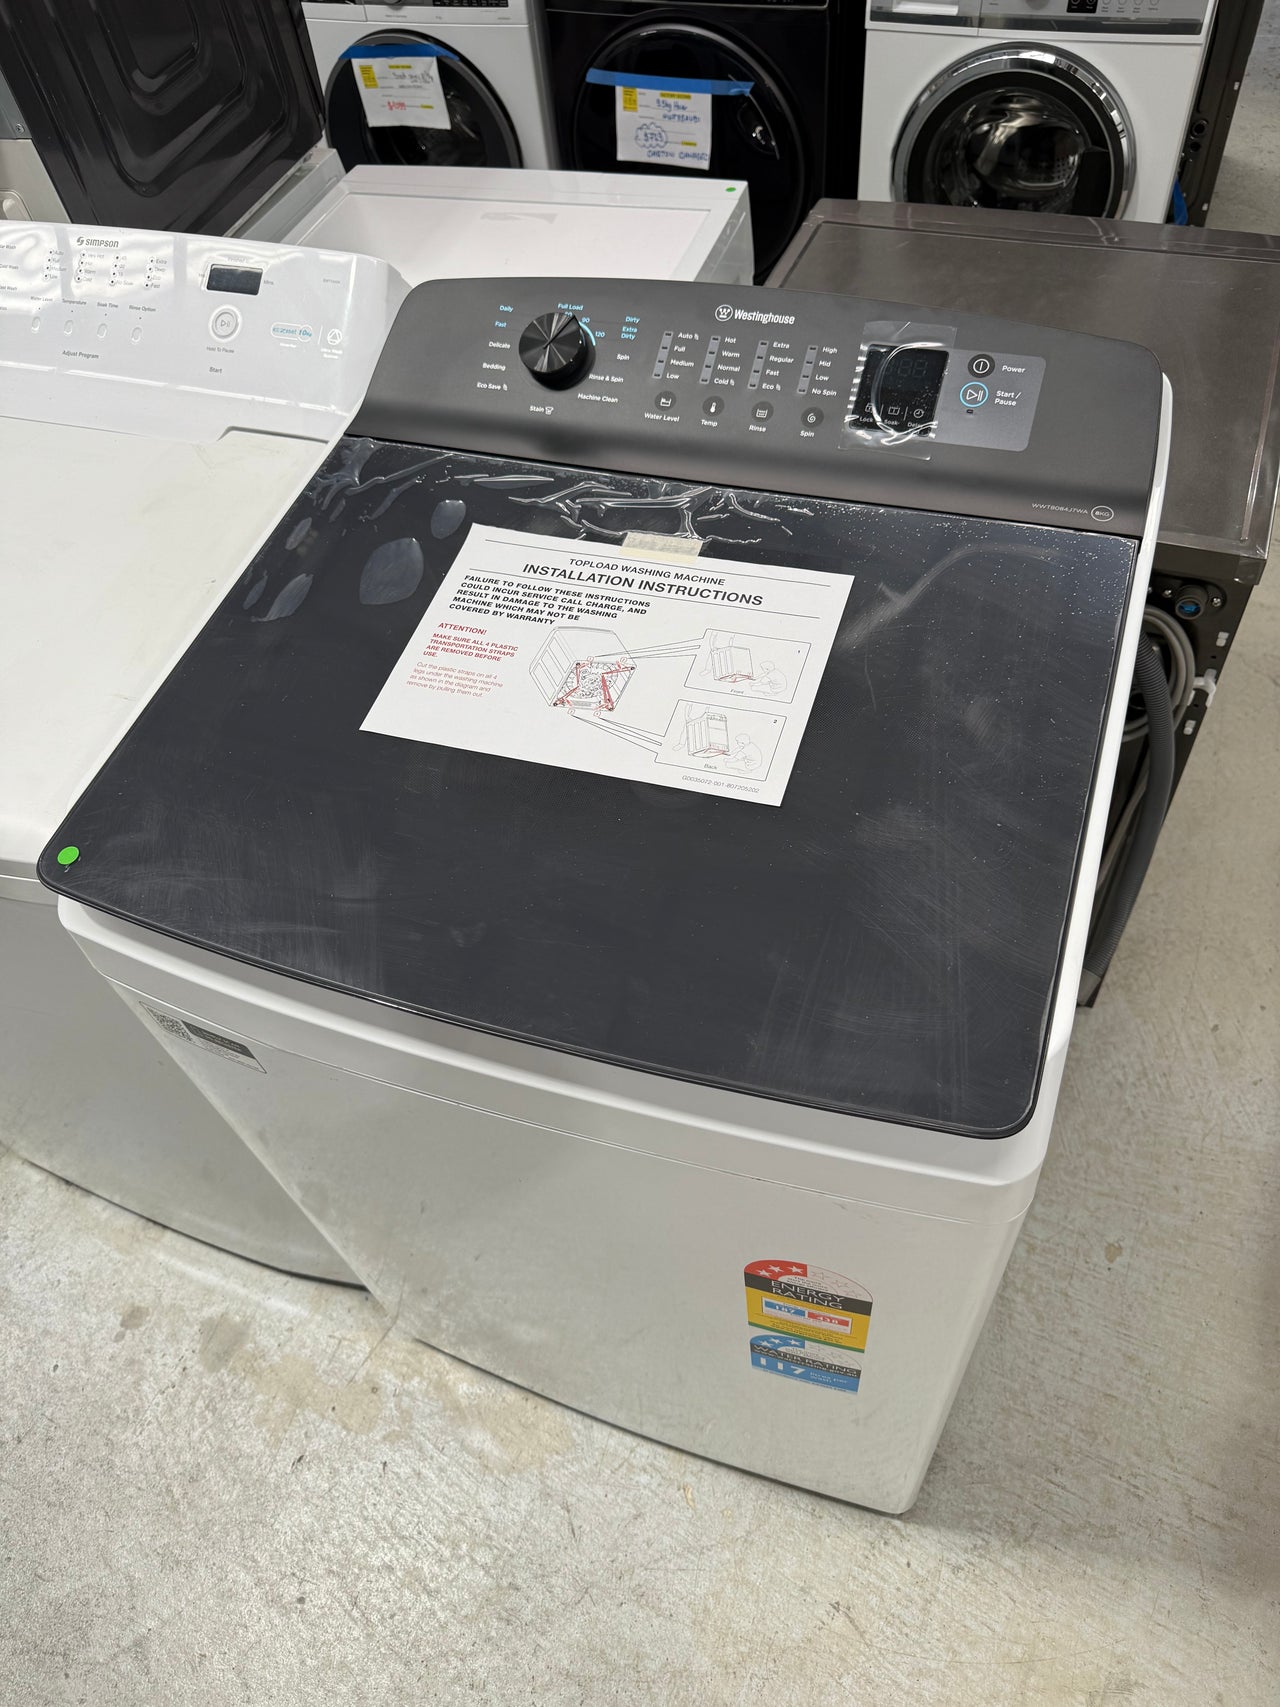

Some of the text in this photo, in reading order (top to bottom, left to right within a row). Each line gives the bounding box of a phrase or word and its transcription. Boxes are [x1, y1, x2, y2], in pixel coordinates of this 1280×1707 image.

[86, 238, 119, 248] SIMPSON
[500, 305, 514, 313] Daily
[626, 316, 640, 324] Dirty
[734, 309, 796, 325] Westinghouse
[621, 332, 636, 341] Dirty
[488, 341, 511, 349] Delicate
[62, 350, 100, 360] Adjust Program
[822, 346, 838, 355] High
[617, 353, 630, 361] Spin
[769, 355, 794, 365] Regular
[482, 363, 506, 372] Bedding
[670, 359, 694, 368] Medium
[718, 364, 740, 372] Normal
[819, 360, 831, 368] Mid
[766, 369, 780, 377] Fast
[1002, 365, 1026, 374] Power
[589, 374, 604, 382] Rinse
[610, 376, 624, 384] Spin
[816, 374, 830, 382] Low
[822, 389, 837, 397] Spin
[996, 390, 1014, 399] Start
[578, 393, 619, 403] Machine Clean
[995, 398, 1017, 406] Pause
[529, 405, 545, 413] Stain
[644, 412, 680, 423] Water Level
[701, 419, 718, 428] Temp
[749, 425, 767, 433] Rinse
[800, 430, 815, 438] Spin
[569, 559, 726, 586] TOPLOAD WASHING MACHINE
[523, 563, 764, 606] INSTALLATION INSTRUCTIONS
[465, 575, 500, 585] FAILURE
[516, 583, 552, 592] FOLLOW
[555, 588, 583, 598] THESE
[585, 593, 651, 608] INSTRUCTIONS
[461, 582, 490, 591] COULD
[492, 587, 520, 596] INCUR
[521, 592, 559, 602] SERVICE
[561, 598, 583, 606] CALL
[586, 601, 625, 612] CHARGE,
[453, 596, 493, 608] MACHINE
[495, 603, 524, 612] WHICH
[526, 608, 545, 616] MAY
[457, 590, 489, 598] RESULT
[502, 597, 540, 607] DAMAGE
[577, 608, 618, 618] WASHING
[449, 604, 490, 614] COVERED
[507, 613, 556, 625] WARRANTY
[438, 623, 488, 635] ATTENTION!
[430, 639, 516, 658] TRANSPORTATION STRAPS
[452, 636, 472, 644] SURE
[491, 642, 519, 652] PLASTIC
[441, 647, 474, 657] REMOVED
[474, 653, 502, 662] BEFORE
[414, 668, 425, 676] legs
[454, 675, 478, 684] washing
[479, 679, 504, 688] machine
[437, 685, 456, 693] pulling
[455, 682, 478, 691] diagram
[772, 1280, 844, 1302] ENERGY
[773, 1288, 842, 1310] RATING
[754, 1345, 802, 1361] WATER
[806, 1356, 857, 1375] RATING
